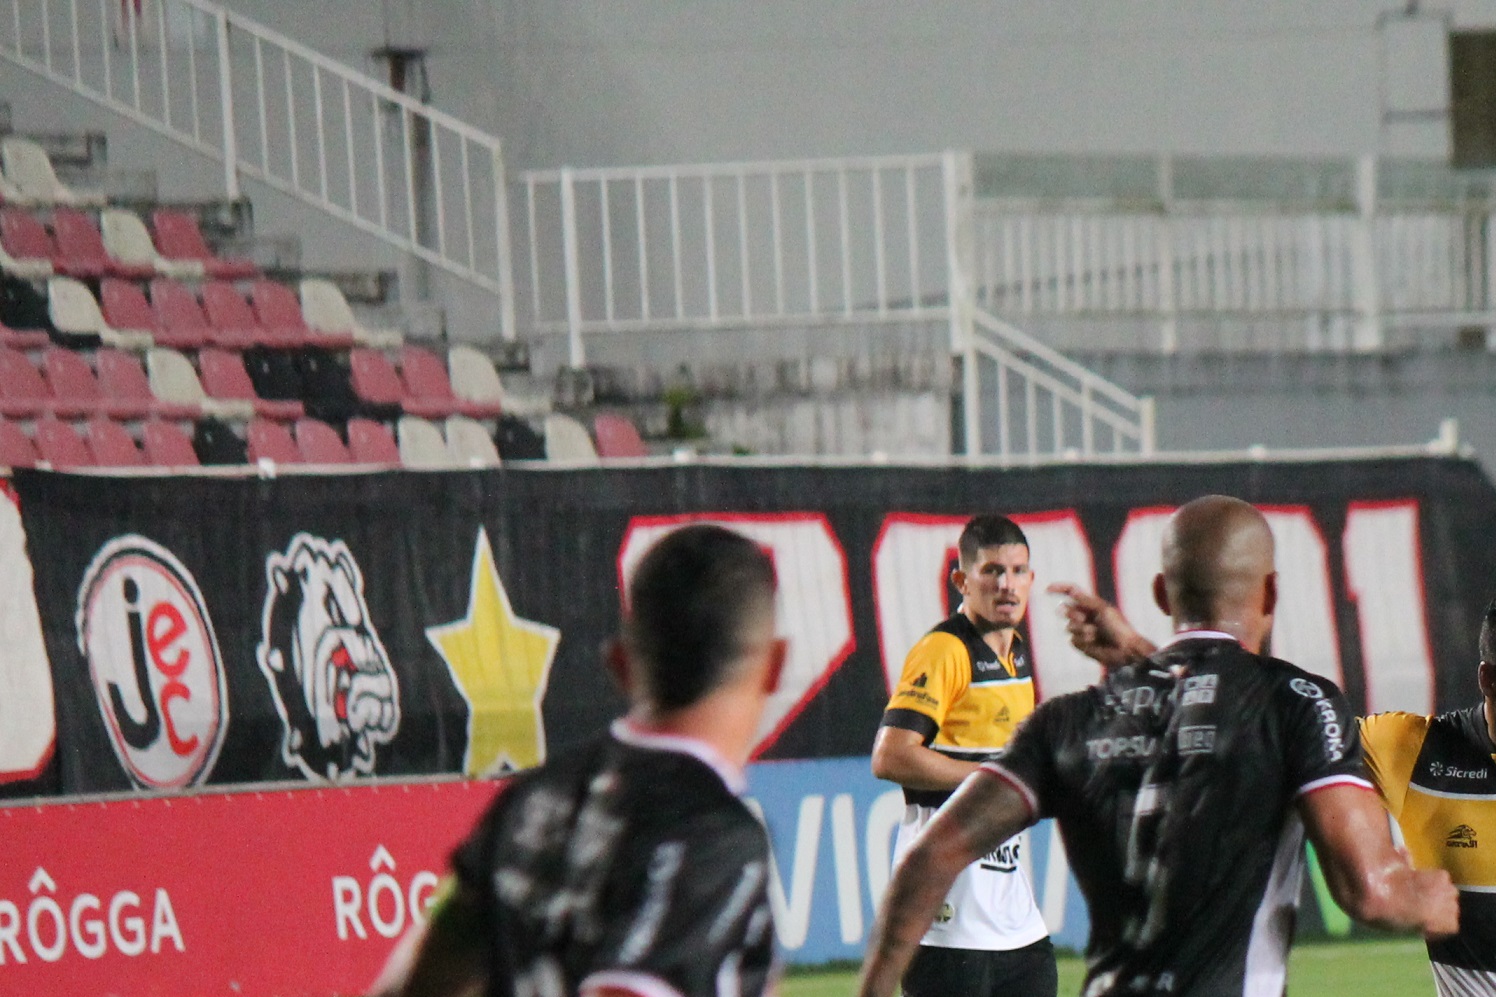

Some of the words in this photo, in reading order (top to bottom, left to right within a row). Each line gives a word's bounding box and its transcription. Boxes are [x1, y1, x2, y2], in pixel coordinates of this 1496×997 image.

[1444, 766, 1488, 779] Sicredi
[0, 865, 185, 965] RÔGGA
[331, 843, 440, 941] RÔG
